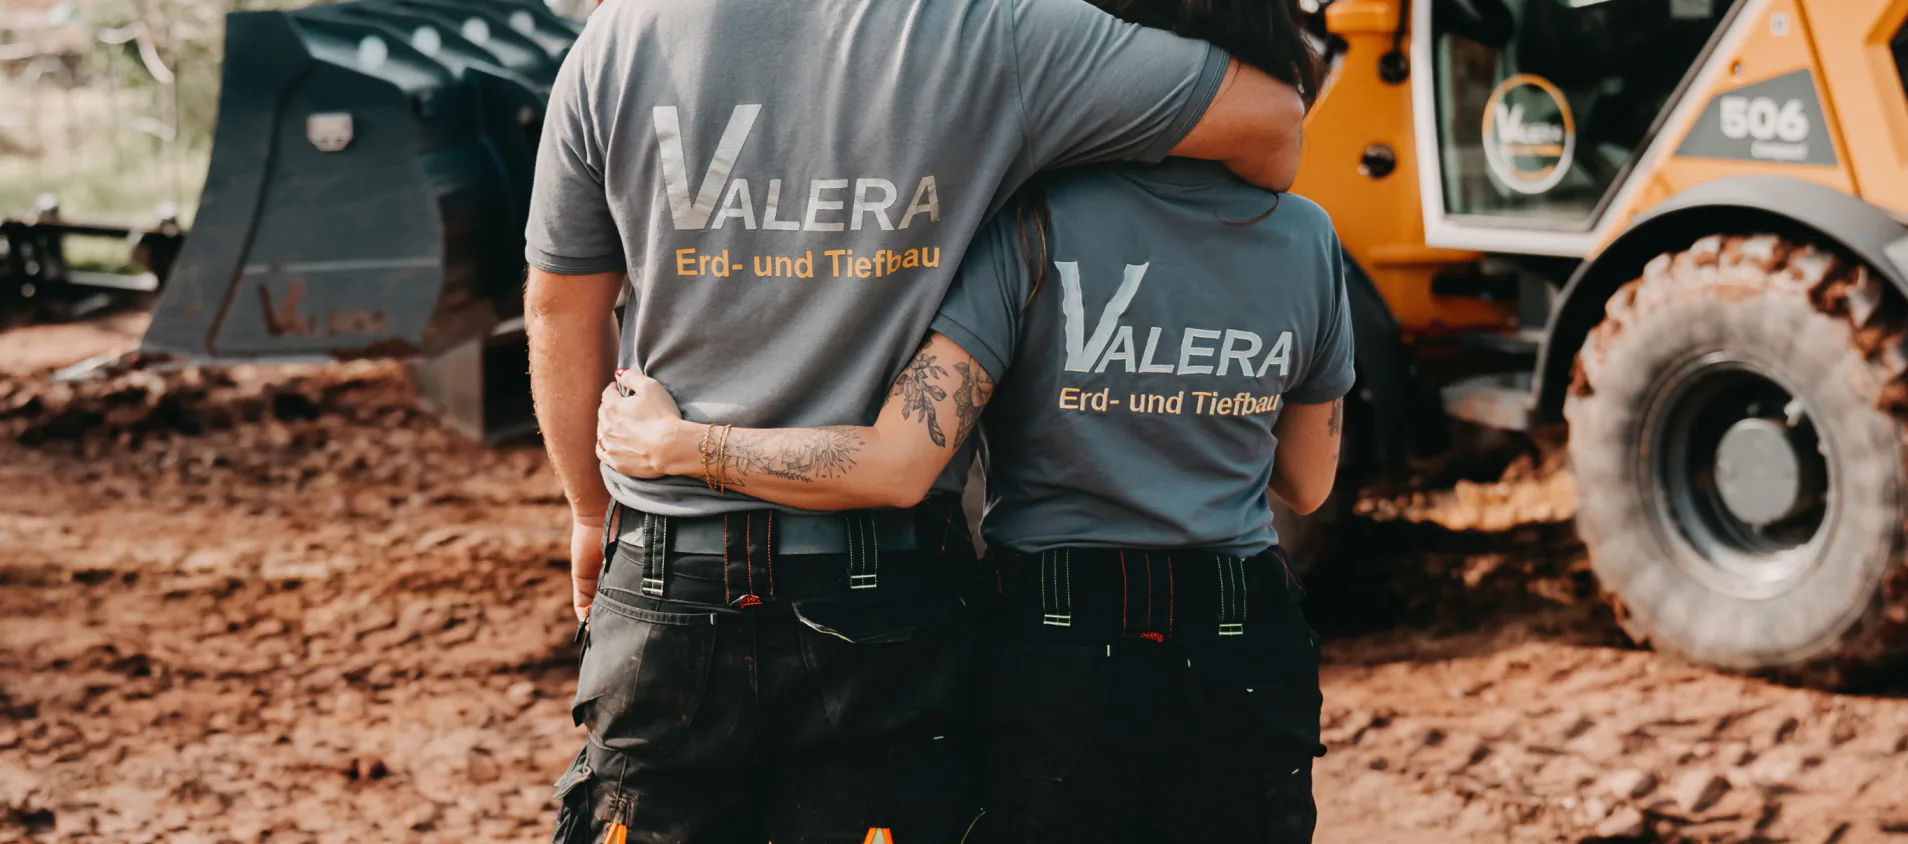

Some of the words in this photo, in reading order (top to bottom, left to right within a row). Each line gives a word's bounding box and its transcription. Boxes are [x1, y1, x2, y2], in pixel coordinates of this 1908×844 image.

[1720, 96, 1809, 142] 506
[653, 104, 940, 231] VALERA
[676, 248, 743, 277] Erd-
[753, 251, 813, 278] und
[824, 247, 940, 278] Tiefbau
[1054, 261, 1292, 377] VALERA
[1059, 387, 1120, 411] Erd-
[1129, 390, 1184, 414] und
[1191, 391, 1280, 415] Tiefbau
